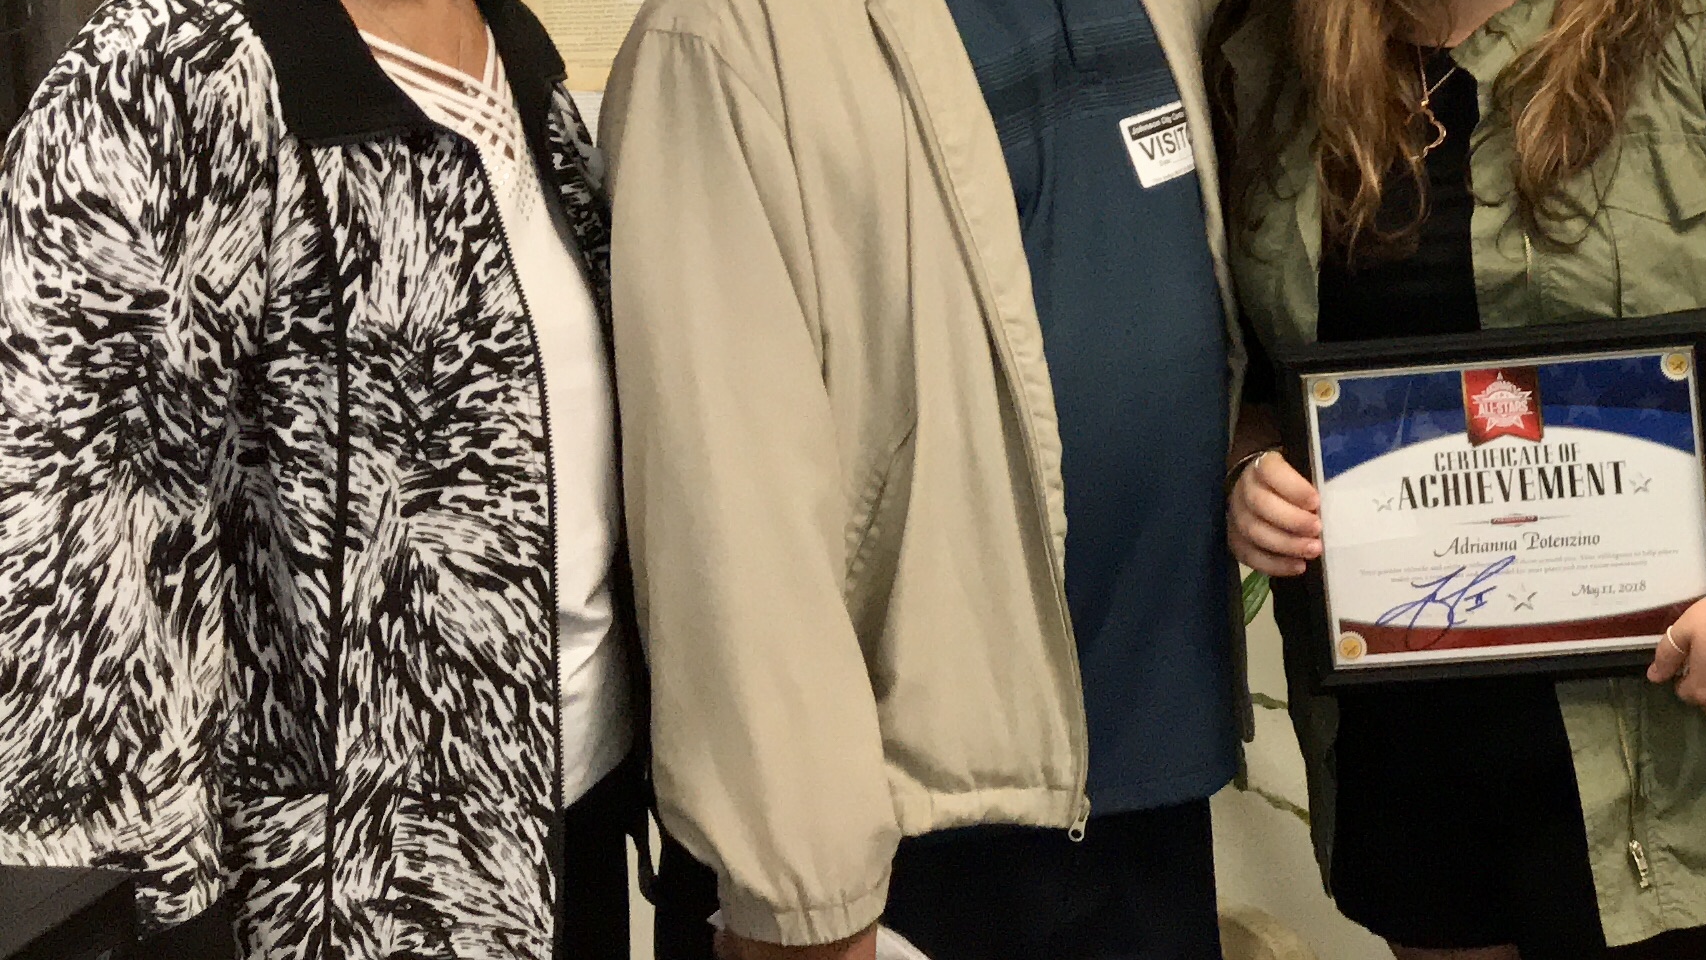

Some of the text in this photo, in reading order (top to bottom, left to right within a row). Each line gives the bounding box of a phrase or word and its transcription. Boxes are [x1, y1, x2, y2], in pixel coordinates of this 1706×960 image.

[1139, 126, 1187, 161] VISIT
[1434, 441, 1581, 473] CERTIFICATE OF
[1397, 459, 1627, 512] ACHIEVEMENT
[1433, 531, 1601, 557] Adrianna Potenzino
[1571, 583, 1600, 598] May
[1618, 579, 1648, 594] 2018
